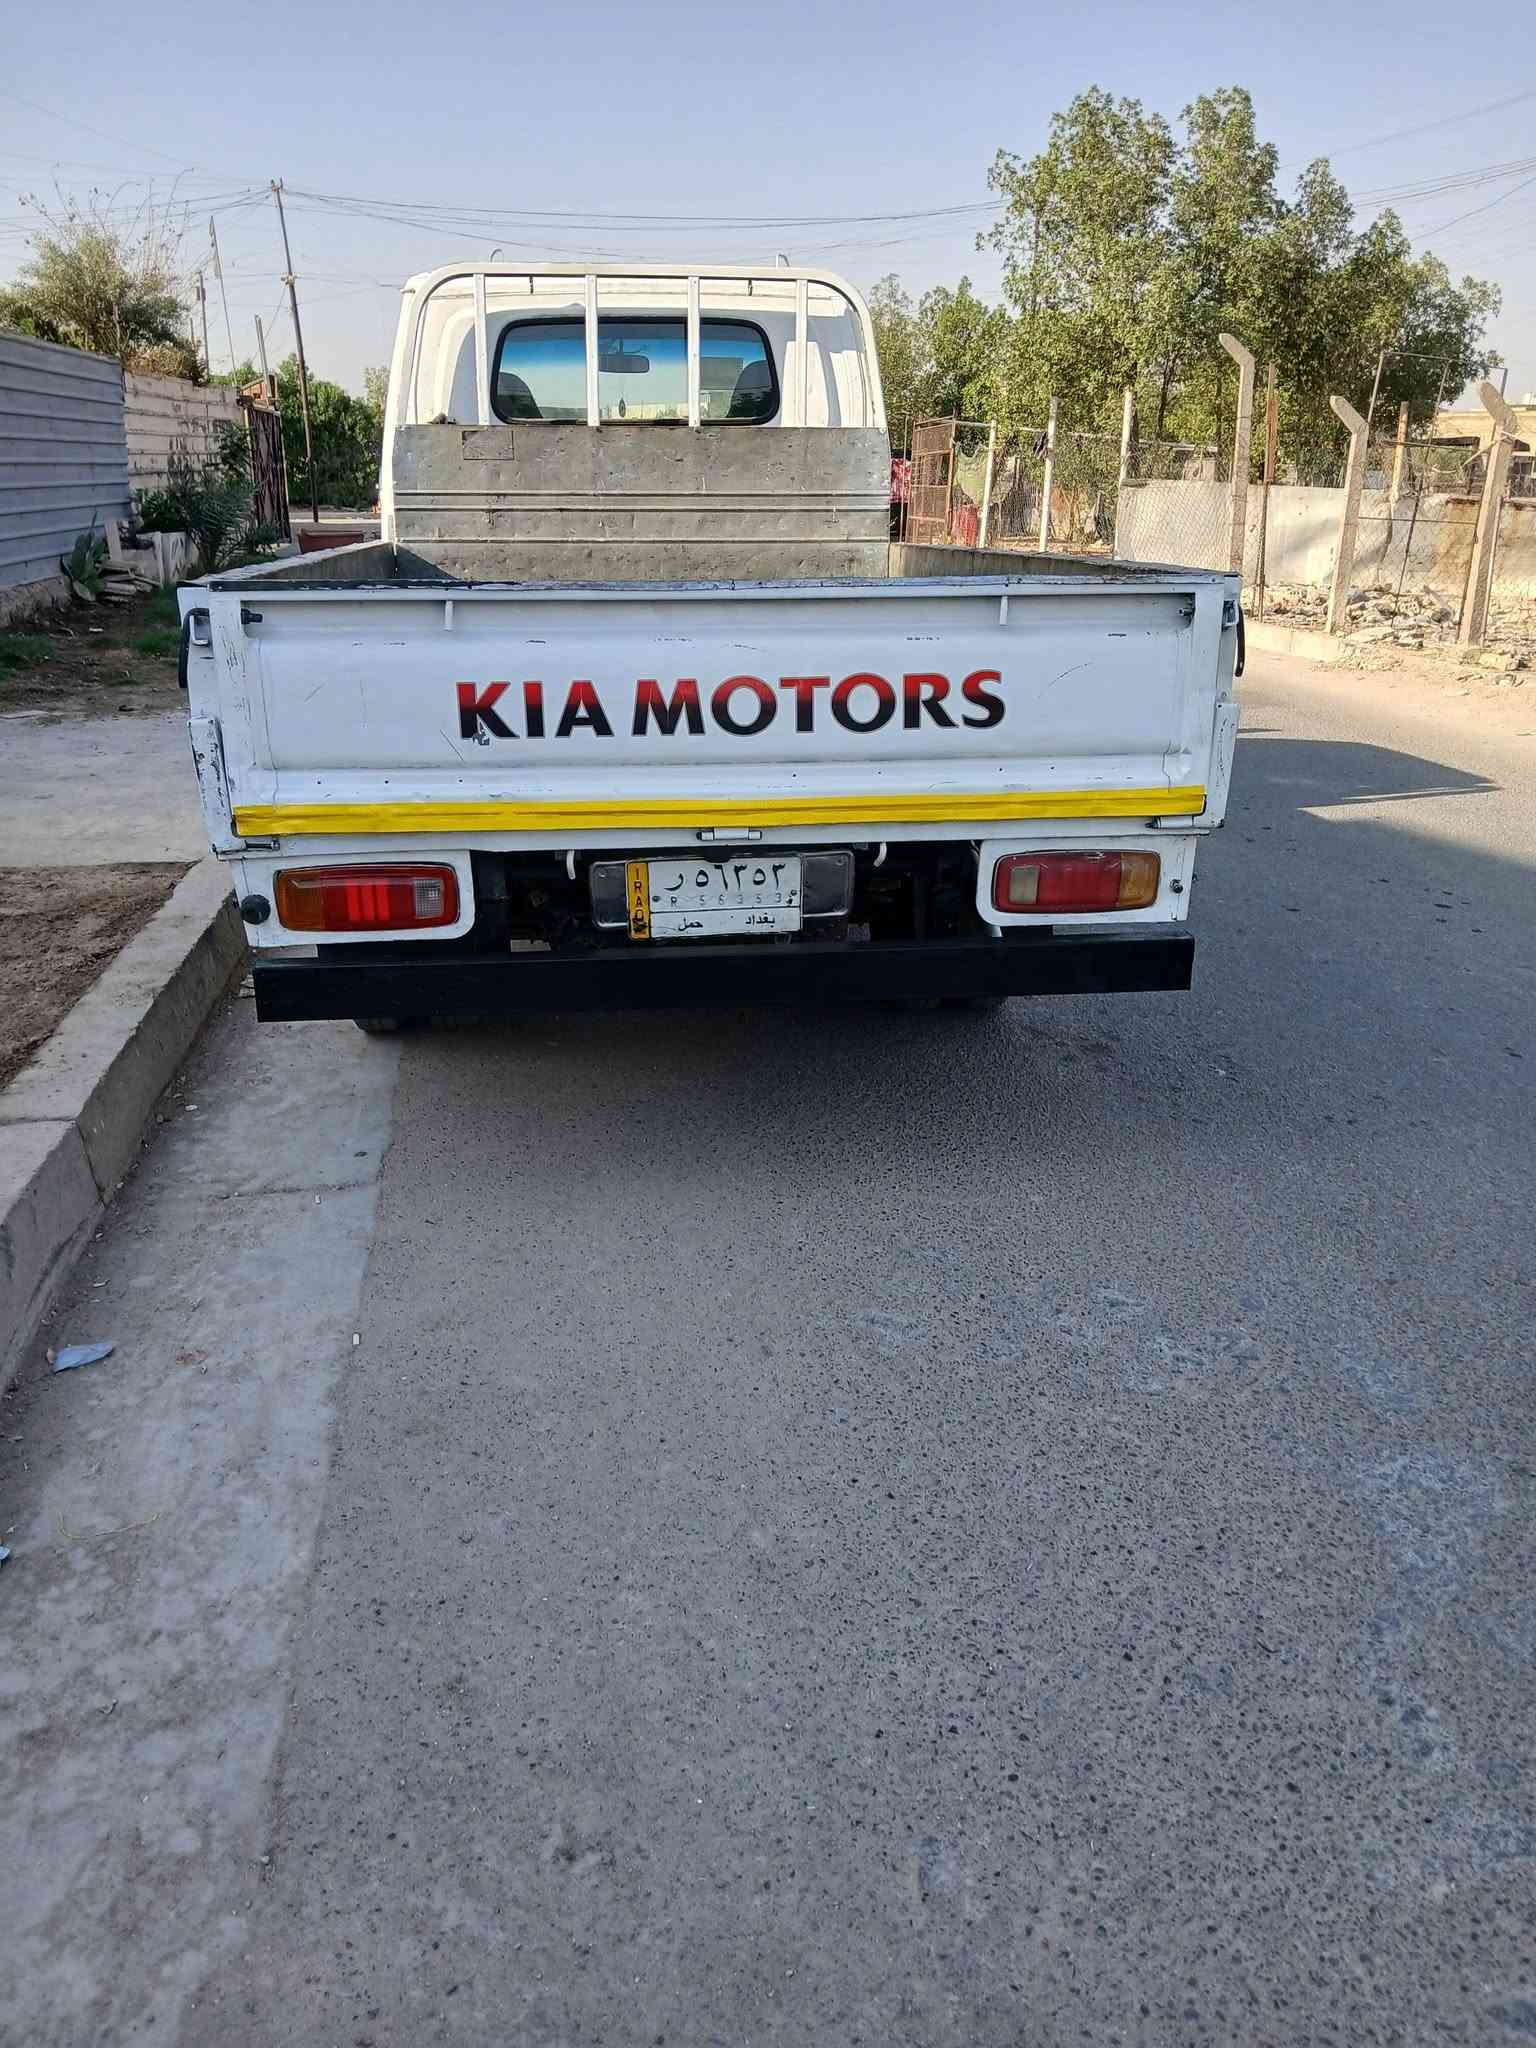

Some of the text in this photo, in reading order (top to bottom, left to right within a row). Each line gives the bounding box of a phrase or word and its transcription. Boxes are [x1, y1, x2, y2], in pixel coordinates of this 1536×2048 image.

[456, 669, 1006, 740] KIA MOTORS
[633, 867, 646, 922] IRAQ
[745, 912, 776, 929] بغداد
